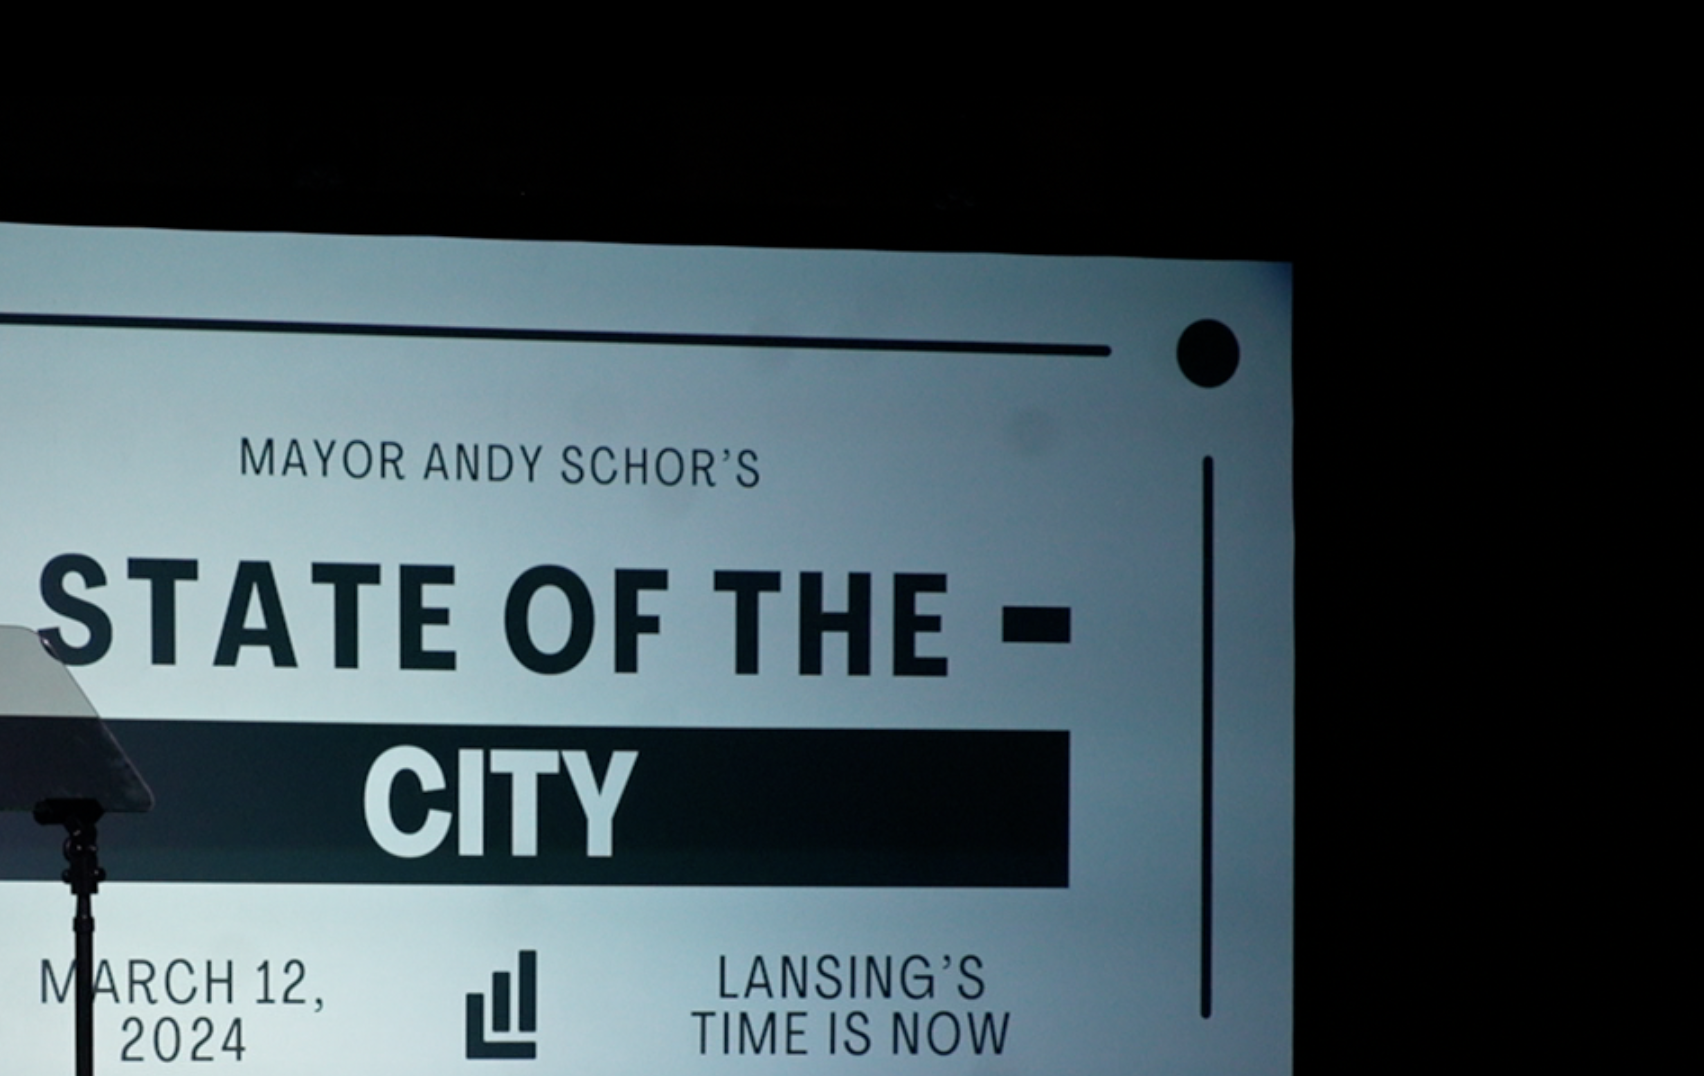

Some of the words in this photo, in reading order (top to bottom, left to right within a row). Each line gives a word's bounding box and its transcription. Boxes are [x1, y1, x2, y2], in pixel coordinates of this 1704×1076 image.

[240, 437, 405, 480] MAYOR
[424, 443, 543, 482] ANDY
[561, 445, 760, 488] SCHOR'S
[38, 553, 457, 671] STATE
[504, 564, 669, 675] OF
[714, 570, 950, 678] THE
[365, 746, 637, 857] CITY
[41, 958, 233, 1005] MARCH
[256, 958, 324, 1013] 12,
[719, 954, 986, 1001] LANSING'S
[120, 1016, 246, 1063] 2024
[691, 1011, 808, 1055] TIME
[829, 1010, 872, 1056] IS
[892, 1010, 1011, 1056] NOW
